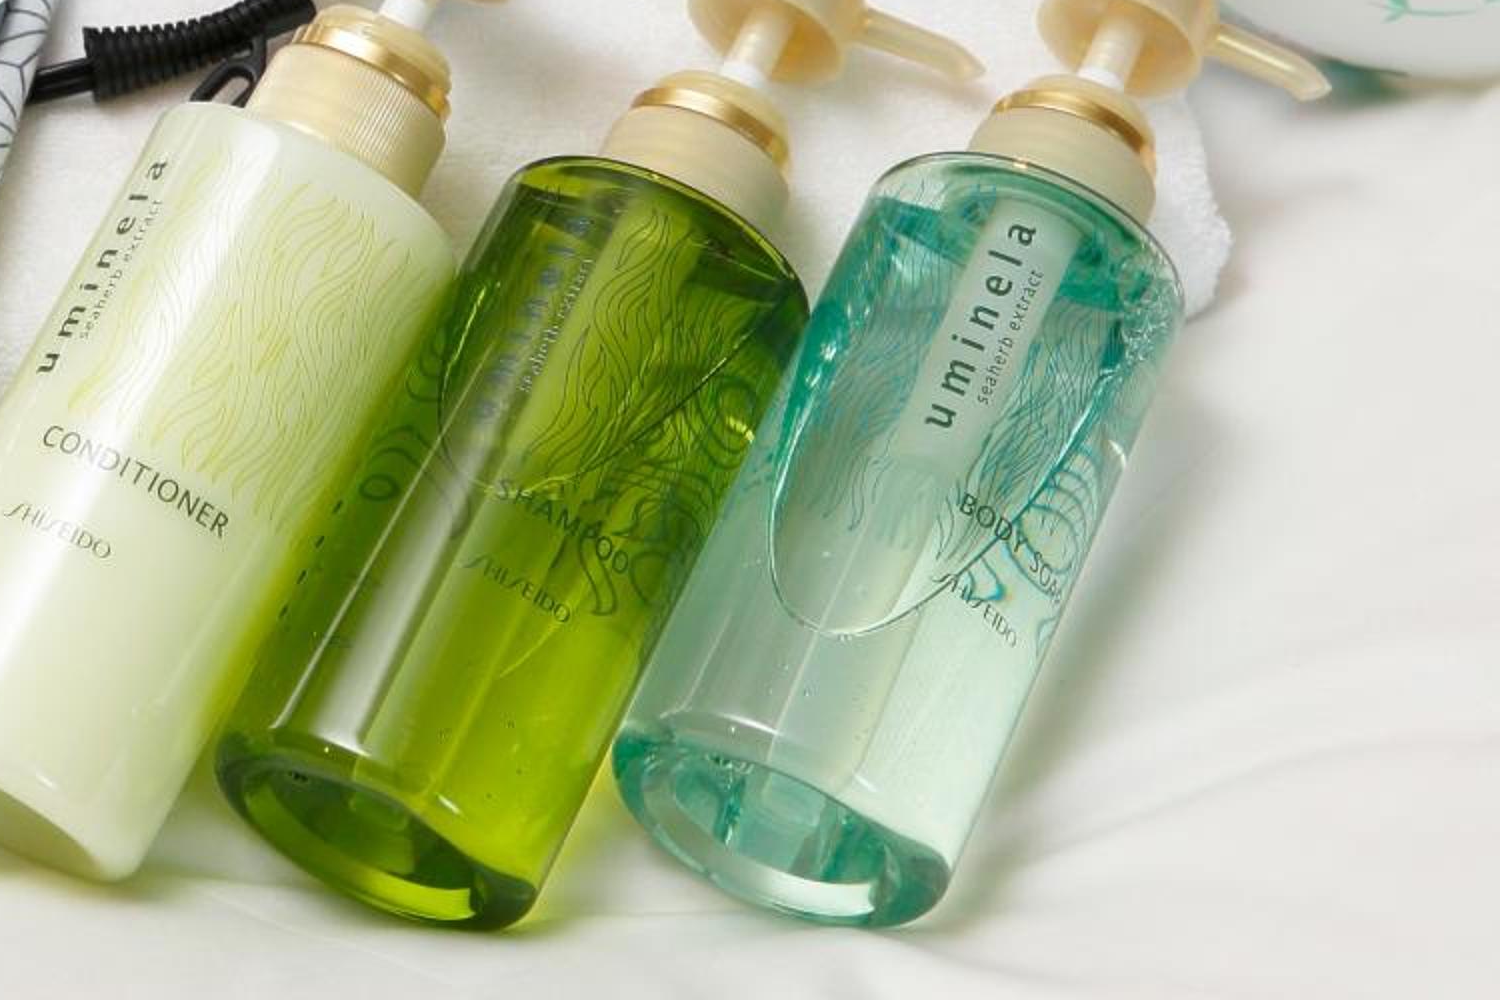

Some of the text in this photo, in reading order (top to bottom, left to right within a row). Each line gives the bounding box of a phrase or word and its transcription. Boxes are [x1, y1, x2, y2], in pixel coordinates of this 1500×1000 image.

[36, 160, 168, 375] uminela
[924, 222, 1037, 429] uminela
[976, 268, 1045, 406] seaherb extract
[42, 424, 230, 539] CONDITIONER
[959, 492, 1030, 553] BODY
[2, 503, 112, 559] SHISEIDO
[462, 553, 571, 623] SHISEIDO
[932, 572, 1018, 648] SHISEIDO
